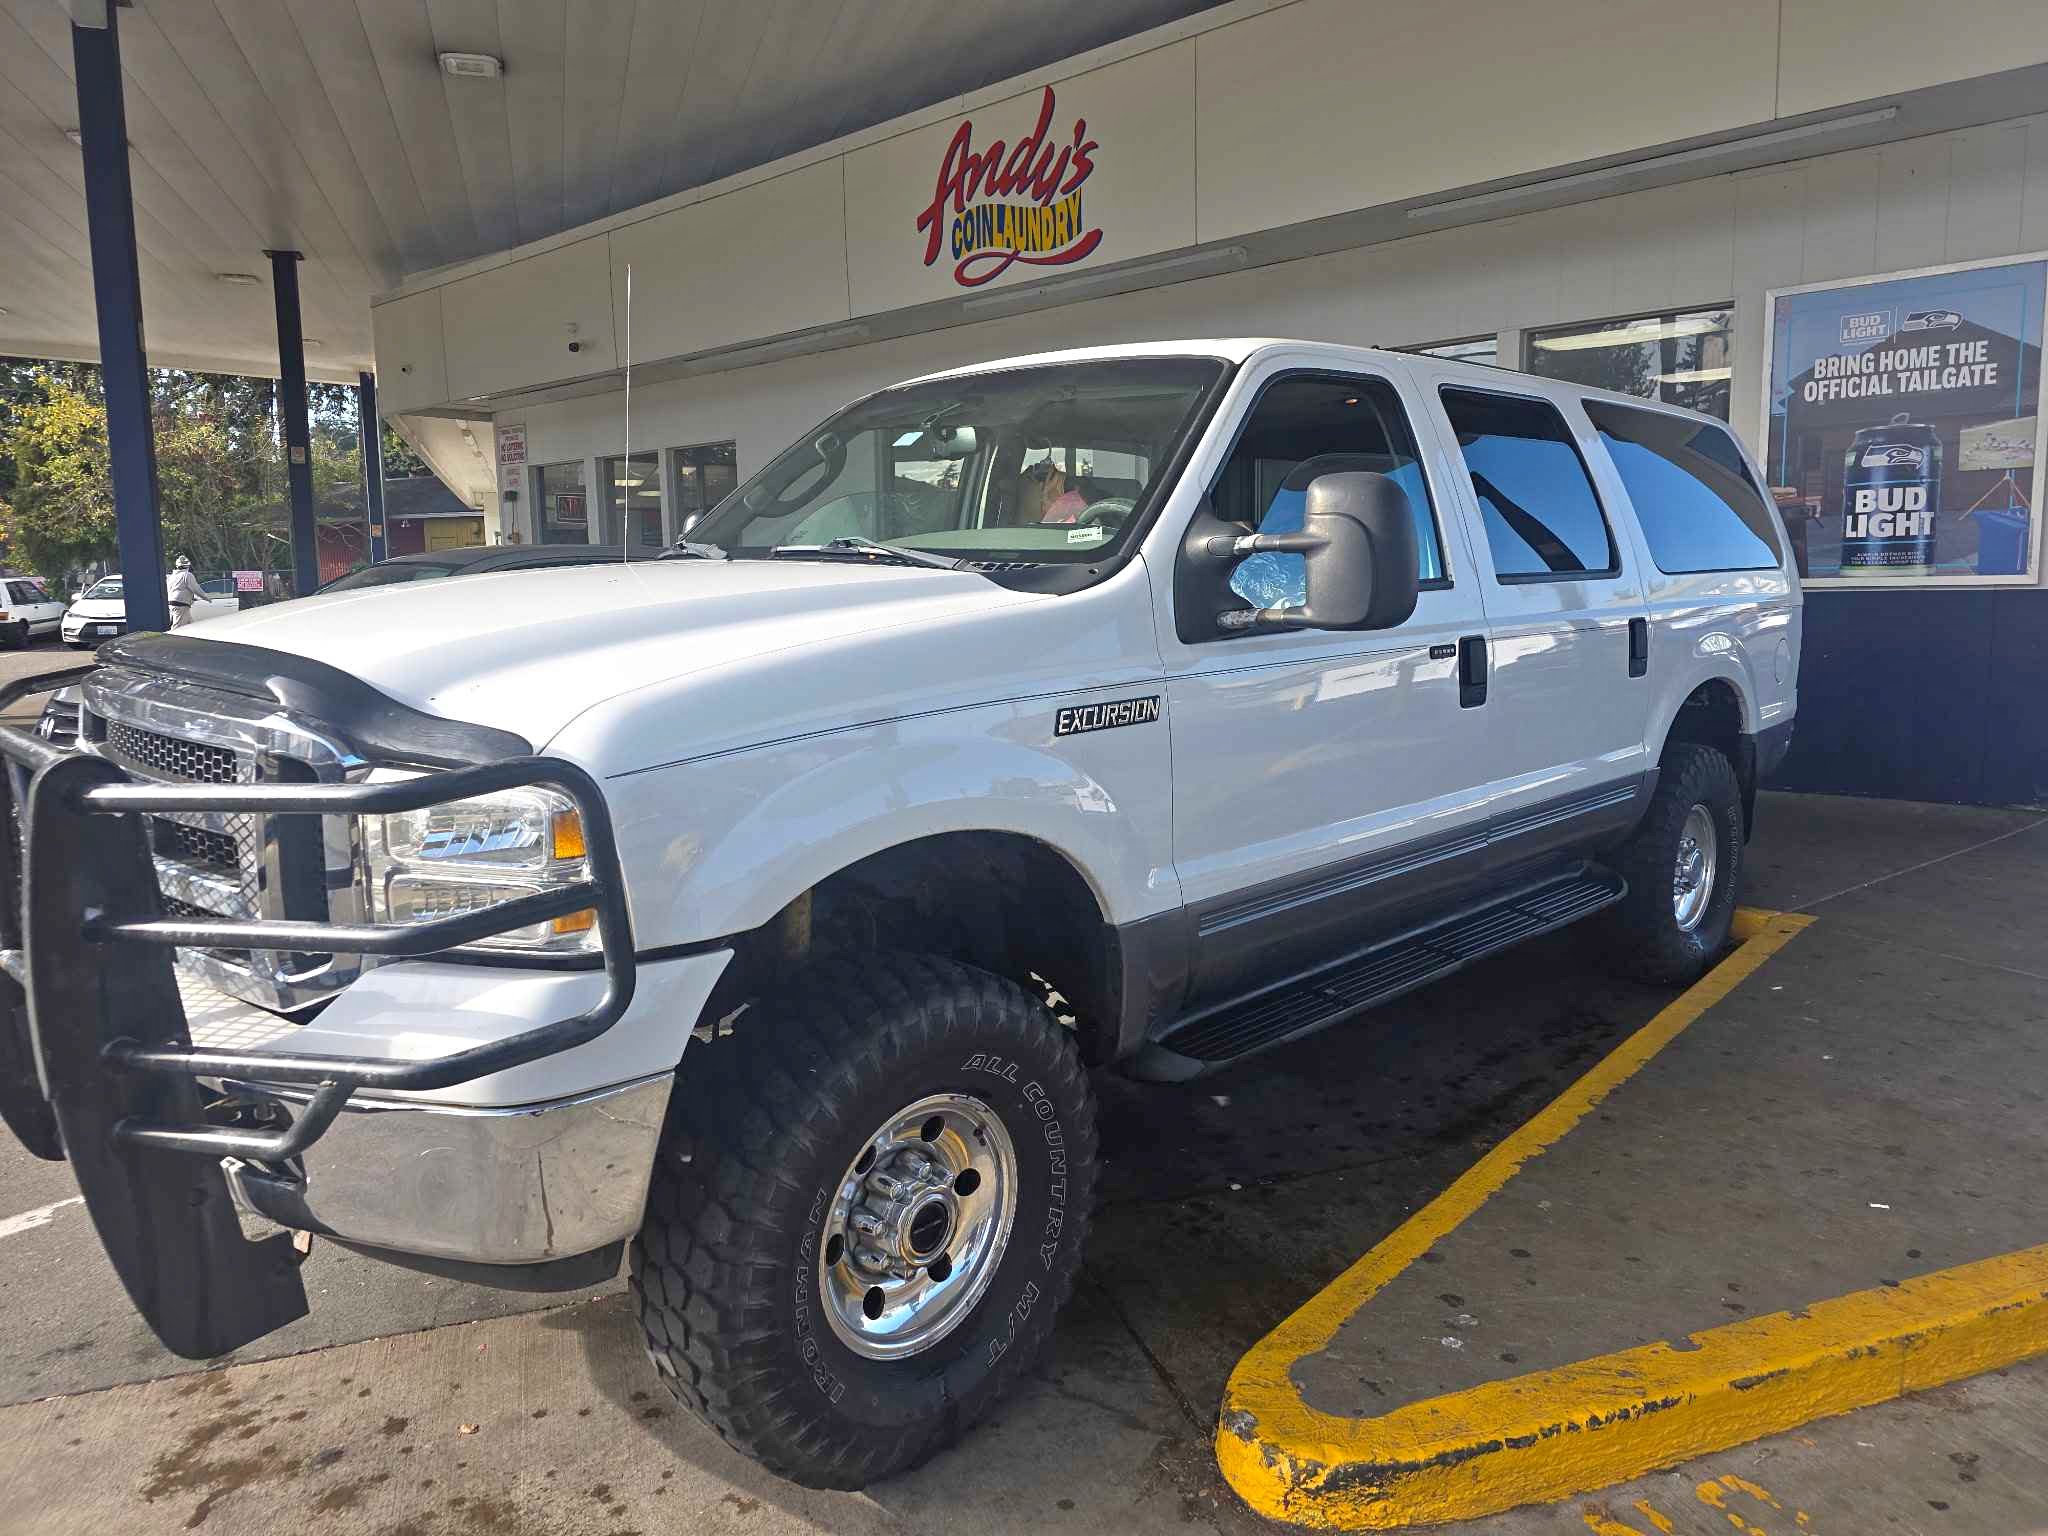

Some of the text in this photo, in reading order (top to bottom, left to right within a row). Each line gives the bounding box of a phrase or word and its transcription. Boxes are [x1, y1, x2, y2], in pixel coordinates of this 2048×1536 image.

[917, 84, 1103, 287] Andy's
[1842, 324, 1887, 340] LIGHT
[1849, 315, 1881, 329] BUD
[1814, 340, 1989, 379] BRING HOME THE
[1803, 363, 1998, 402] OFFICIAL TAILGATE
[1855, 486, 1927, 514] BUD
[1845, 511, 1935, 538] LIGHT
[1057, 697, 1160, 735] EXCURSION
[960, 1054, 1019, 1084] ALL
[1022, 1080, 1067, 1272] COUNTRY
[795, 1186, 846, 1404] IRONMAN
